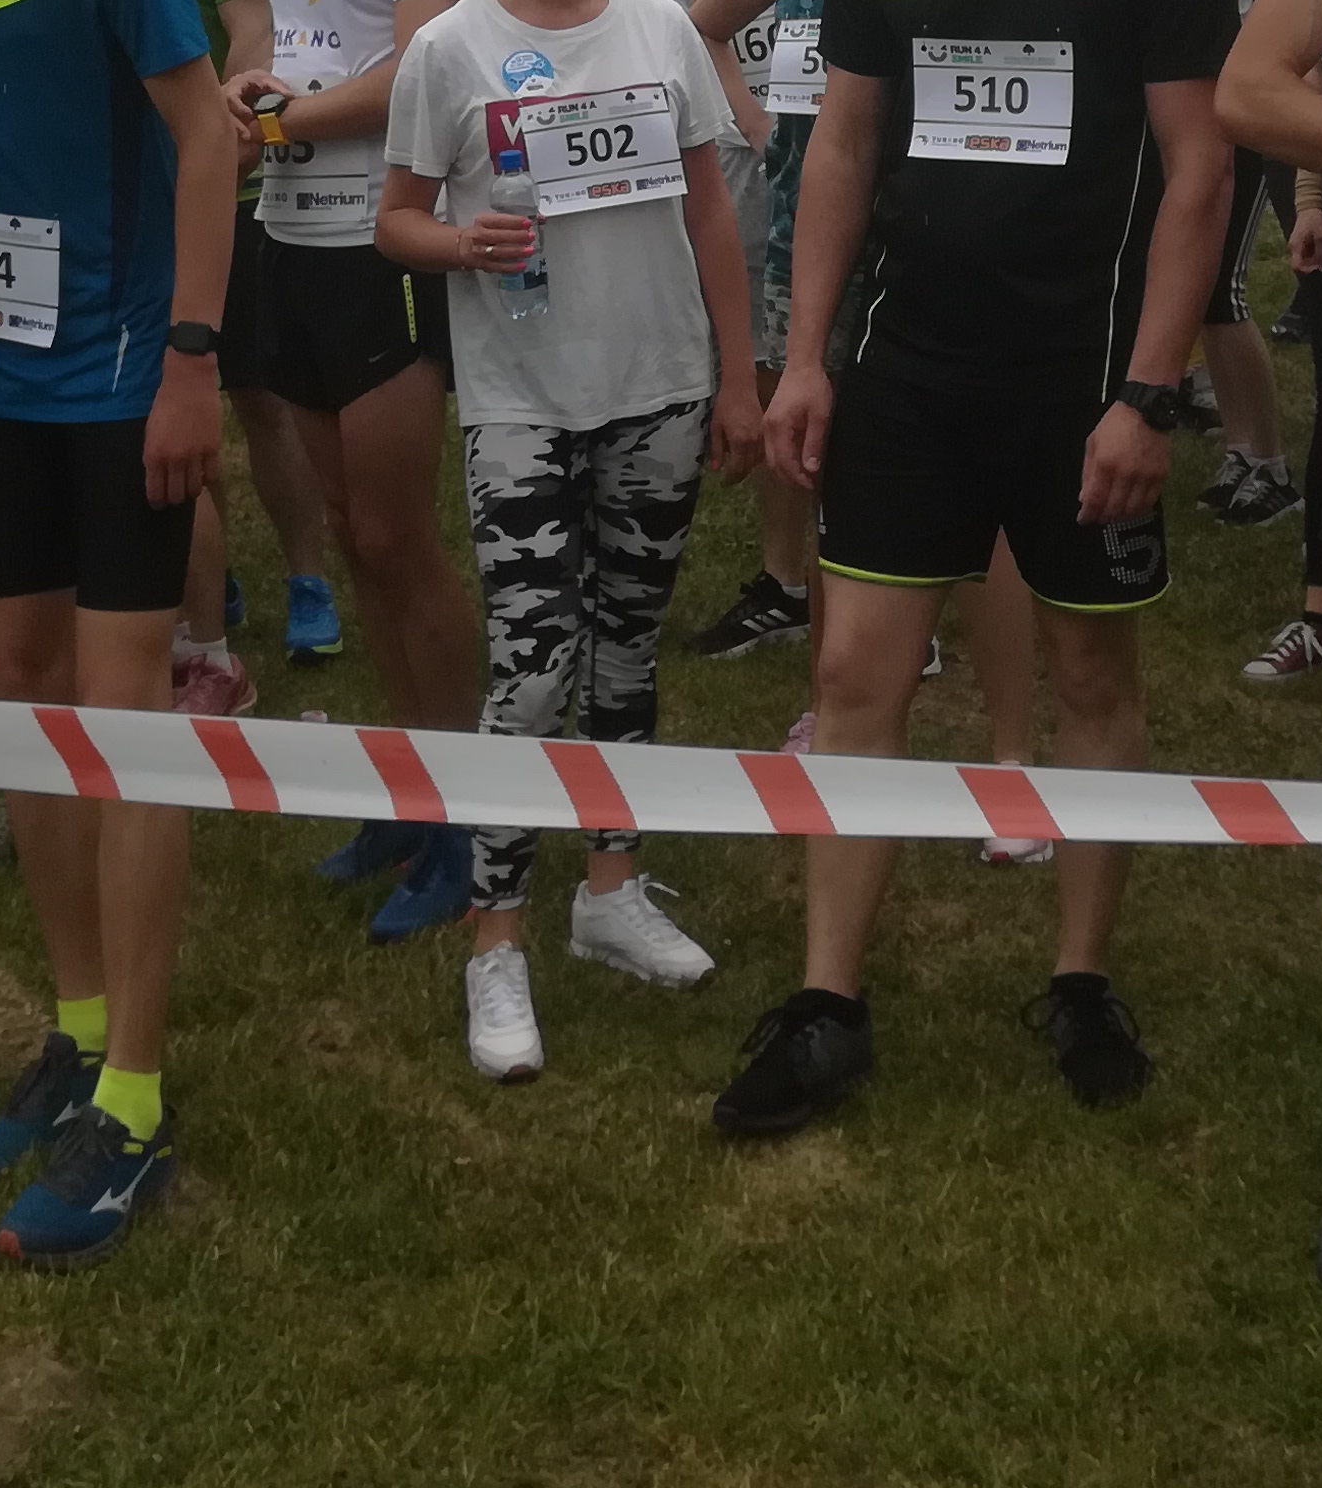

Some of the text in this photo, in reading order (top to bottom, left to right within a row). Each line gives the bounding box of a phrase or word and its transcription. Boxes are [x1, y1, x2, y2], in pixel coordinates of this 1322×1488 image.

[953, 75, 1030, 115] 510
[566, 124, 639, 166] 502
[309, 191, 366, 206] Netrium
